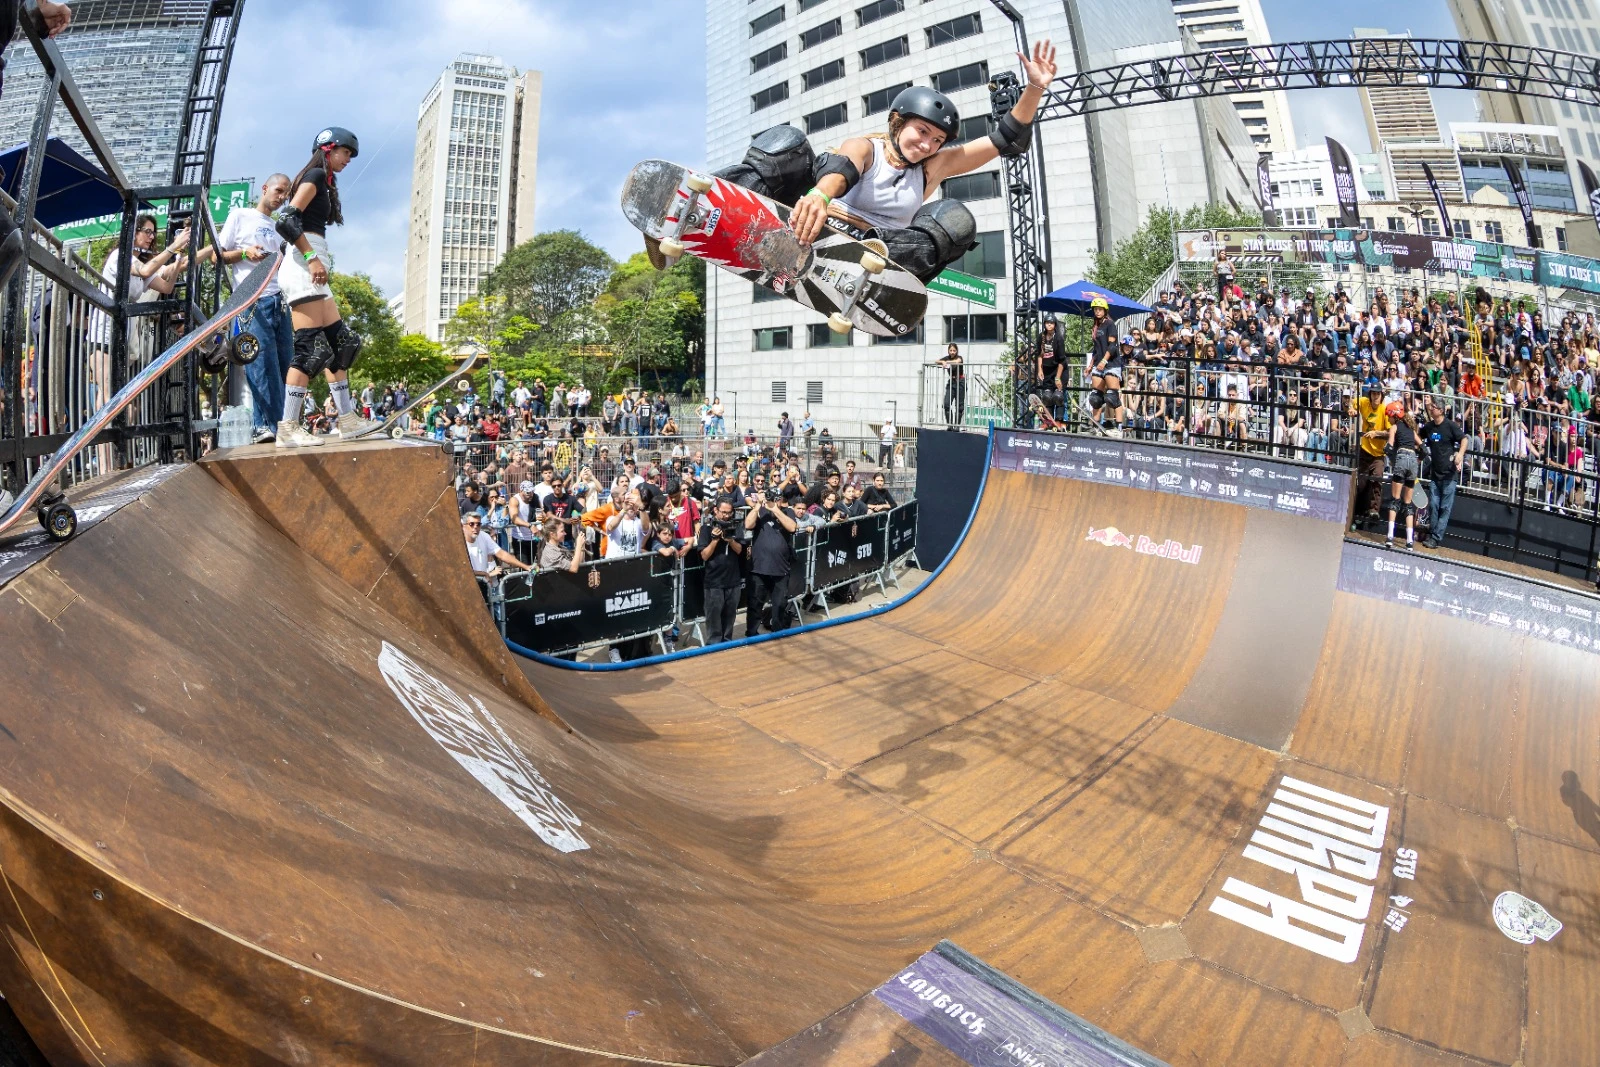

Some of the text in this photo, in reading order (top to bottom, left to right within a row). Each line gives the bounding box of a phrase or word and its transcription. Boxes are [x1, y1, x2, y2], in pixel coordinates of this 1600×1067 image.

[1243, 239, 1356, 253] STAY CLOSE TO THIS AREA
[1549, 262, 1568, 278] STAY
[1569, 266, 1592, 283] CLOSE
[938, 278, 949, 286] DE
[863, 299, 900, 328] Baw
[1105, 467, 1123, 480] STU
[1218, 483, 1238, 497] STU
[857, 543, 872, 560] STU
[605, 591, 652, 613] BRASIL
[547, 609, 582, 621] PETROBRAS
[1392, 847, 1418, 880] STU
